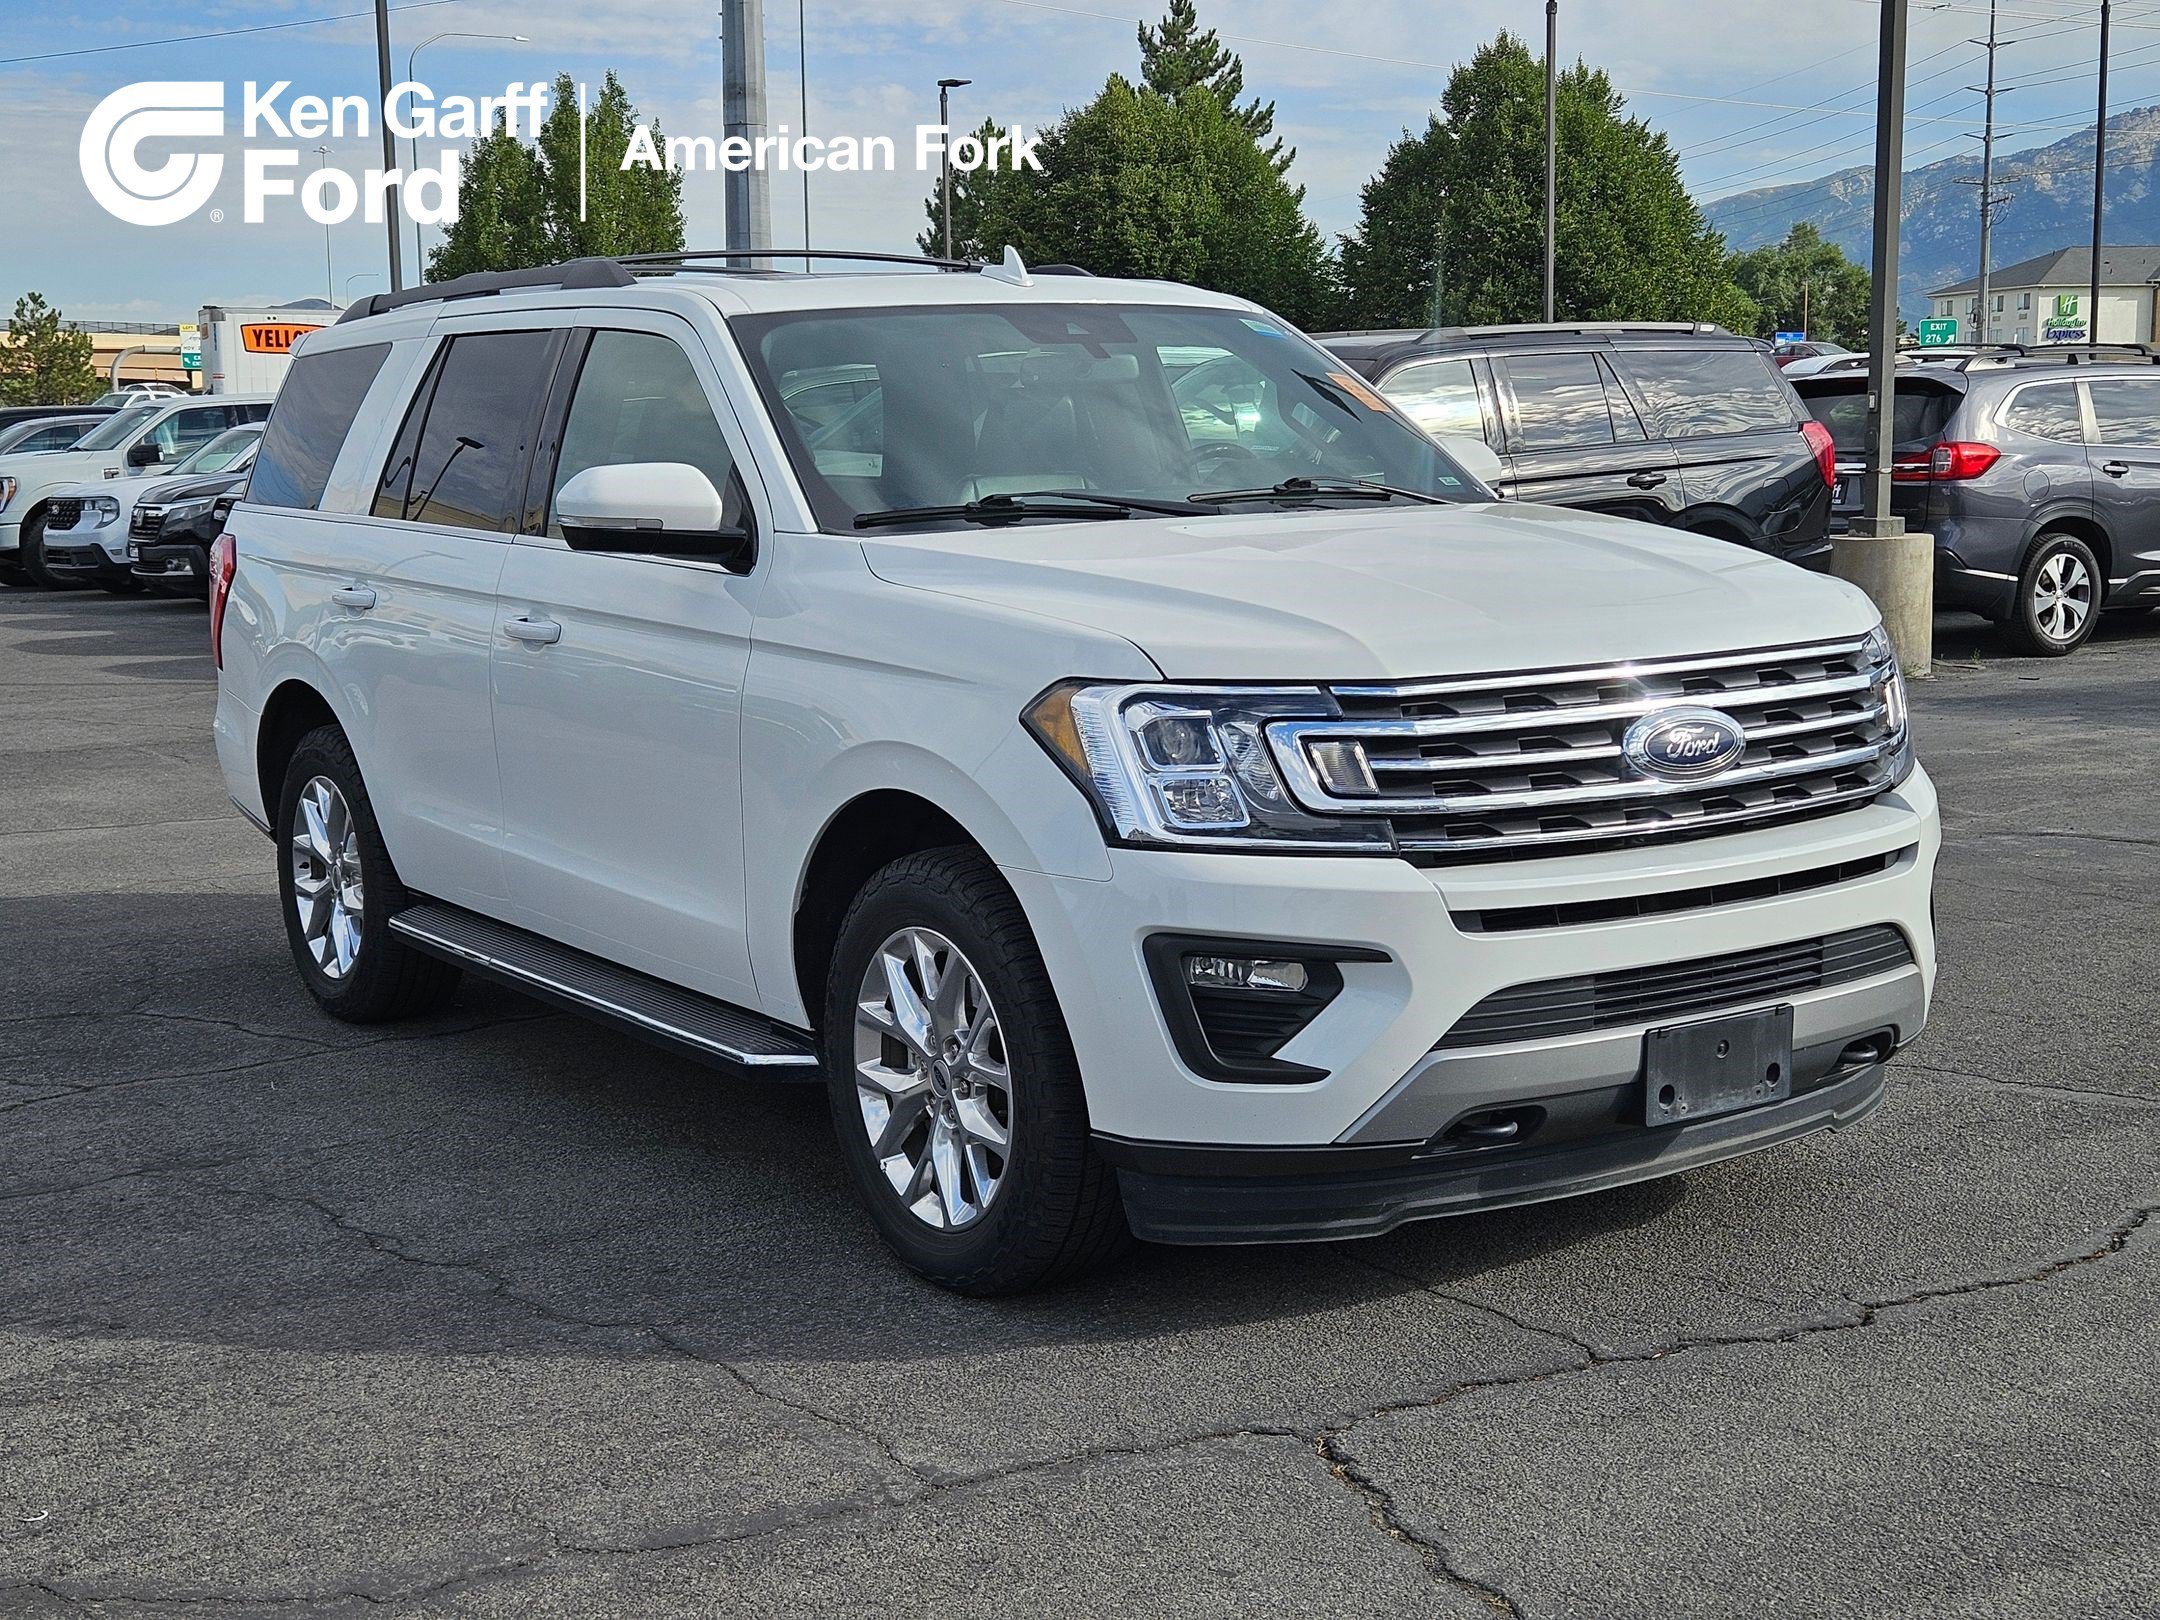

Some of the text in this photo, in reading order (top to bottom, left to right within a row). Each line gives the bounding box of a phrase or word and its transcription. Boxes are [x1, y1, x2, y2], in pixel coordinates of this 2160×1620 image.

[1930, 323, 1947, 331] EXIT
[252, 329, 313, 348] YELL
[1925, 334, 1942, 343] 276
[2046, 328, 2087, 341] Express
[1666, 727, 1720, 758] Ford
